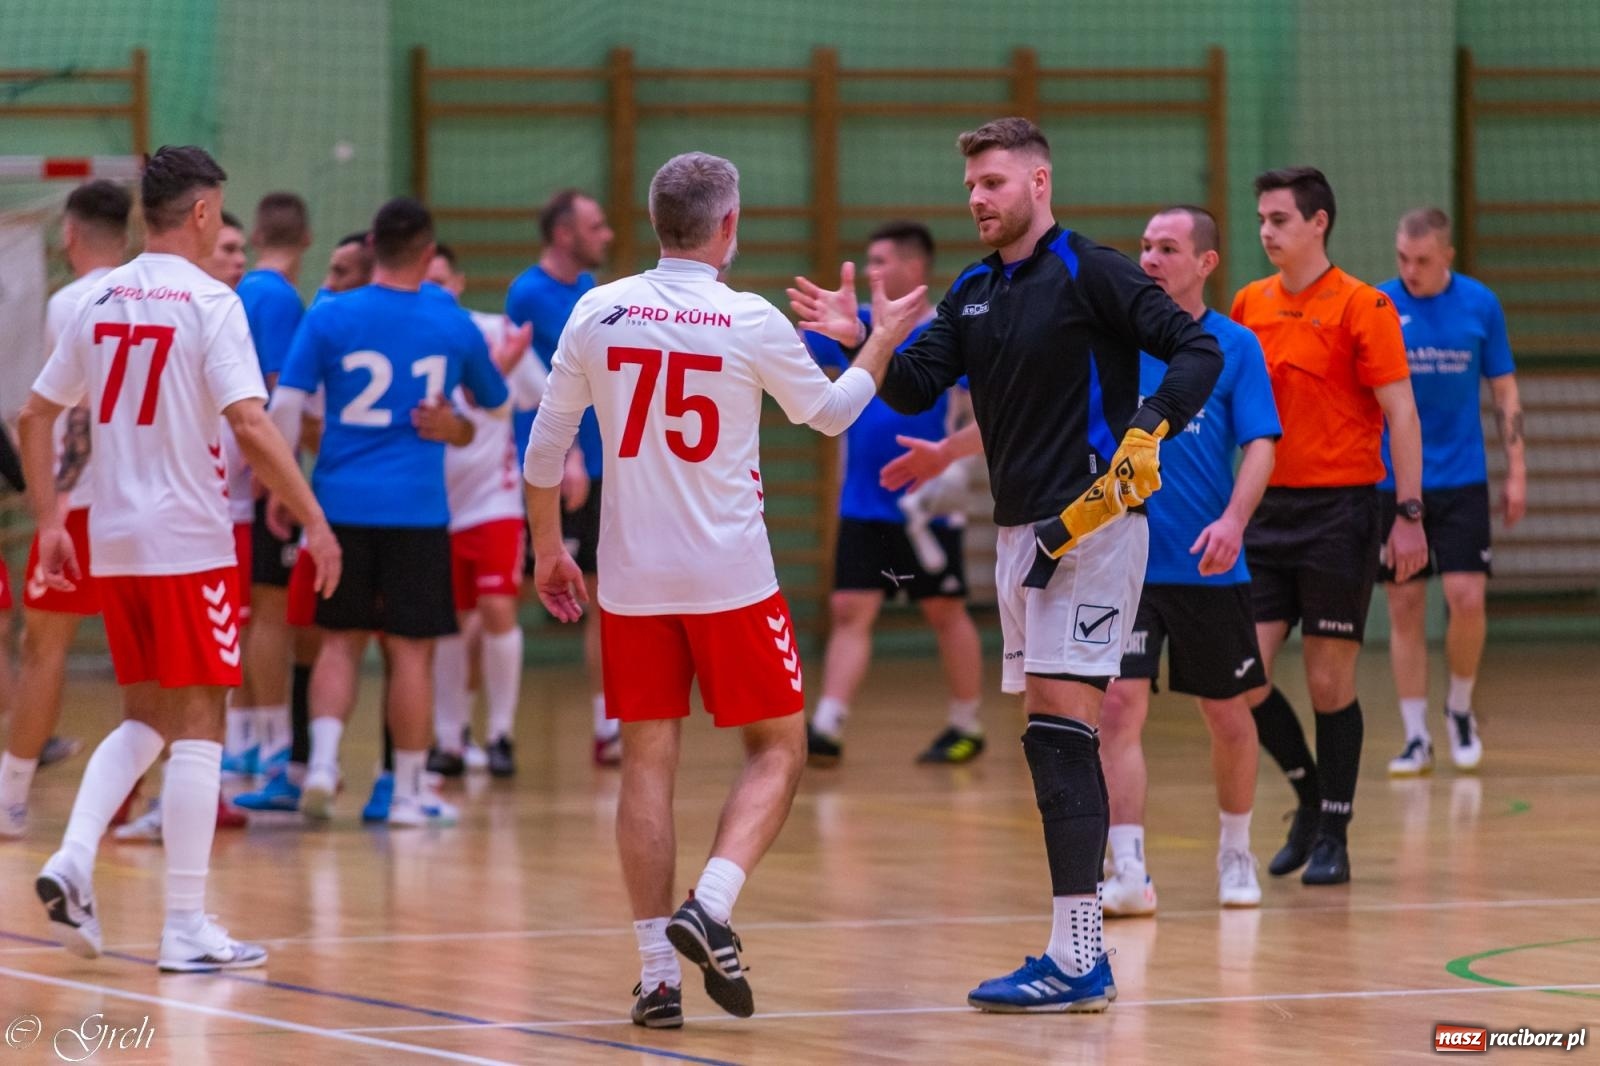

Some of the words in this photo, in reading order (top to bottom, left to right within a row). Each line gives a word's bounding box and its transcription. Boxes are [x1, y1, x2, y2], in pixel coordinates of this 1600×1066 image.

[114, 285, 143, 301] PRD
[147, 286, 191, 303] KÜHN
[627, 305, 669, 321] PRD
[674, 308, 731, 327] KÜHN
[94, 323, 176, 425] 77
[341, 350, 447, 427] 21
[607, 346, 723, 463] 75
